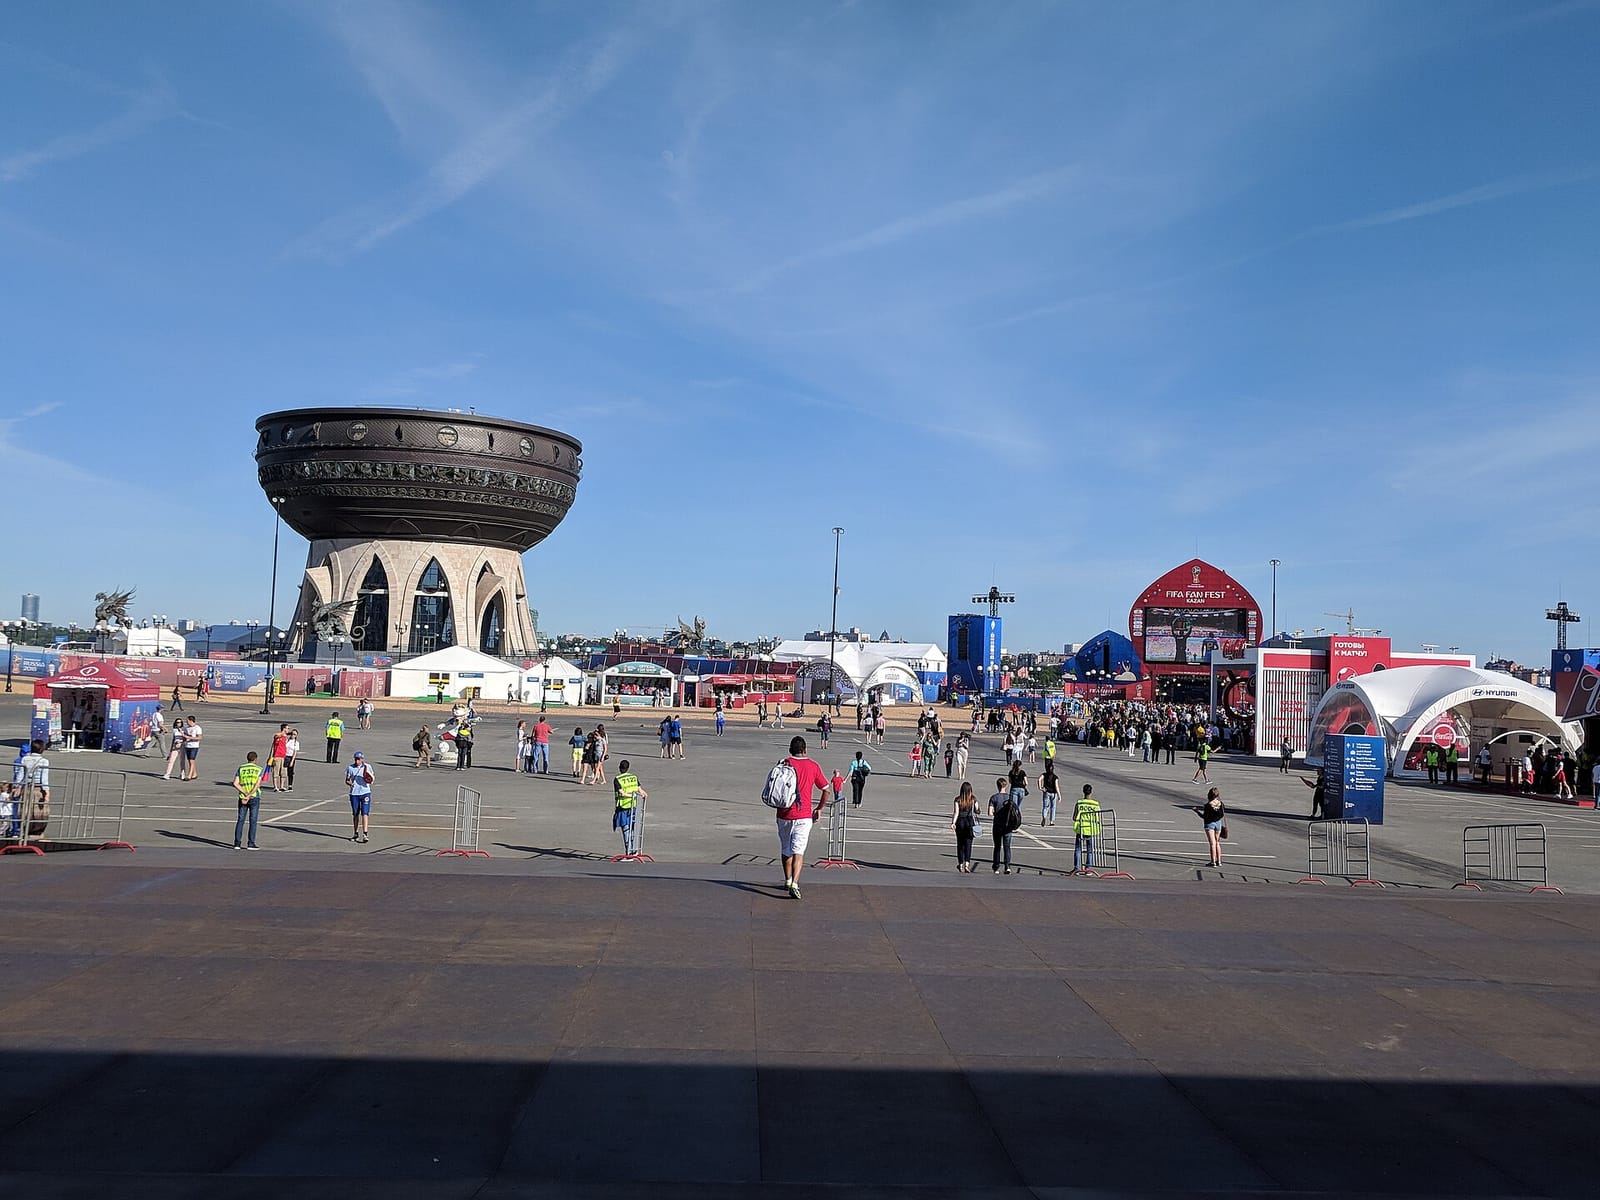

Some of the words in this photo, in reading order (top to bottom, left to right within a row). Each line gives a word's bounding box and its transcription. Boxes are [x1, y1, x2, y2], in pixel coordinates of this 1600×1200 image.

[1185, 591, 1204, 599] FAN
[1204, 591, 1226, 599] FEST
[177, 668, 196, 677] FIFA
